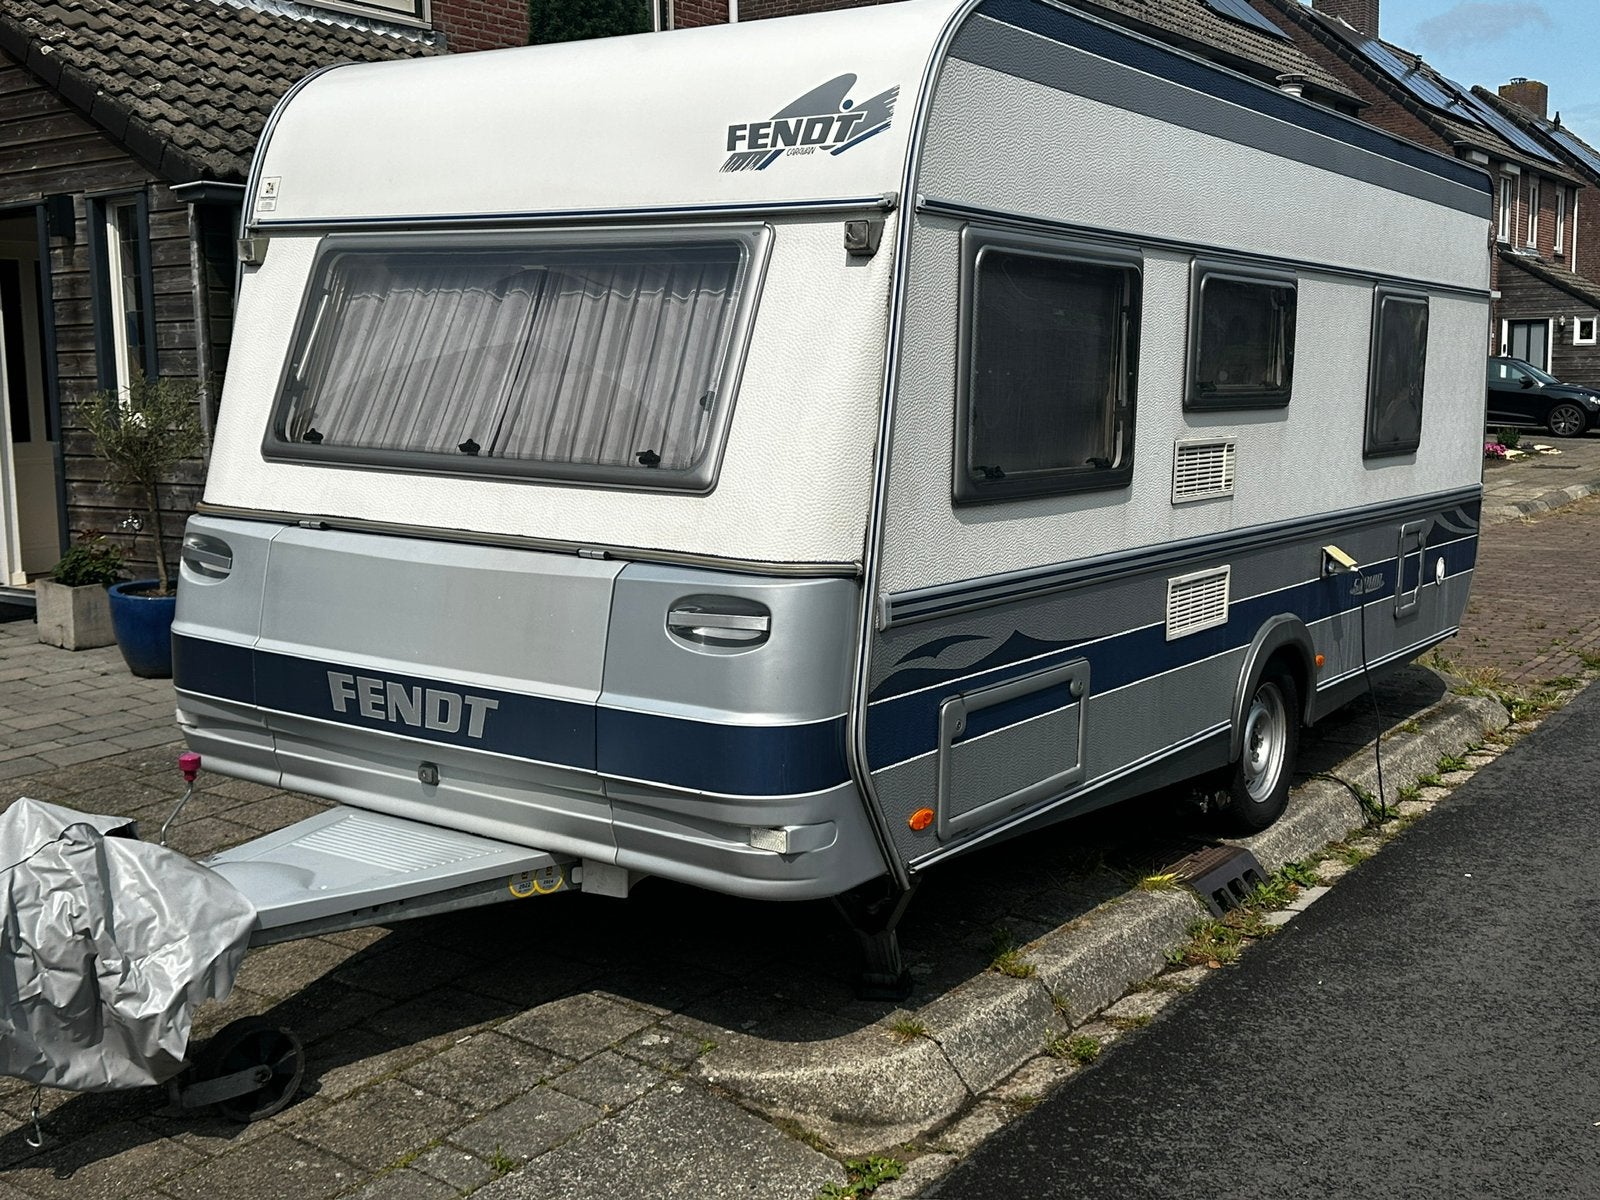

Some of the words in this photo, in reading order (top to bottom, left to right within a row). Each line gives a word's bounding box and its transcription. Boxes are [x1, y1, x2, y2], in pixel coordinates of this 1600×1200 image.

[726, 113, 865, 151] FENDT
[786, 147, 814, 157] CARAVAN
[327, 670, 500, 739] FENDT
